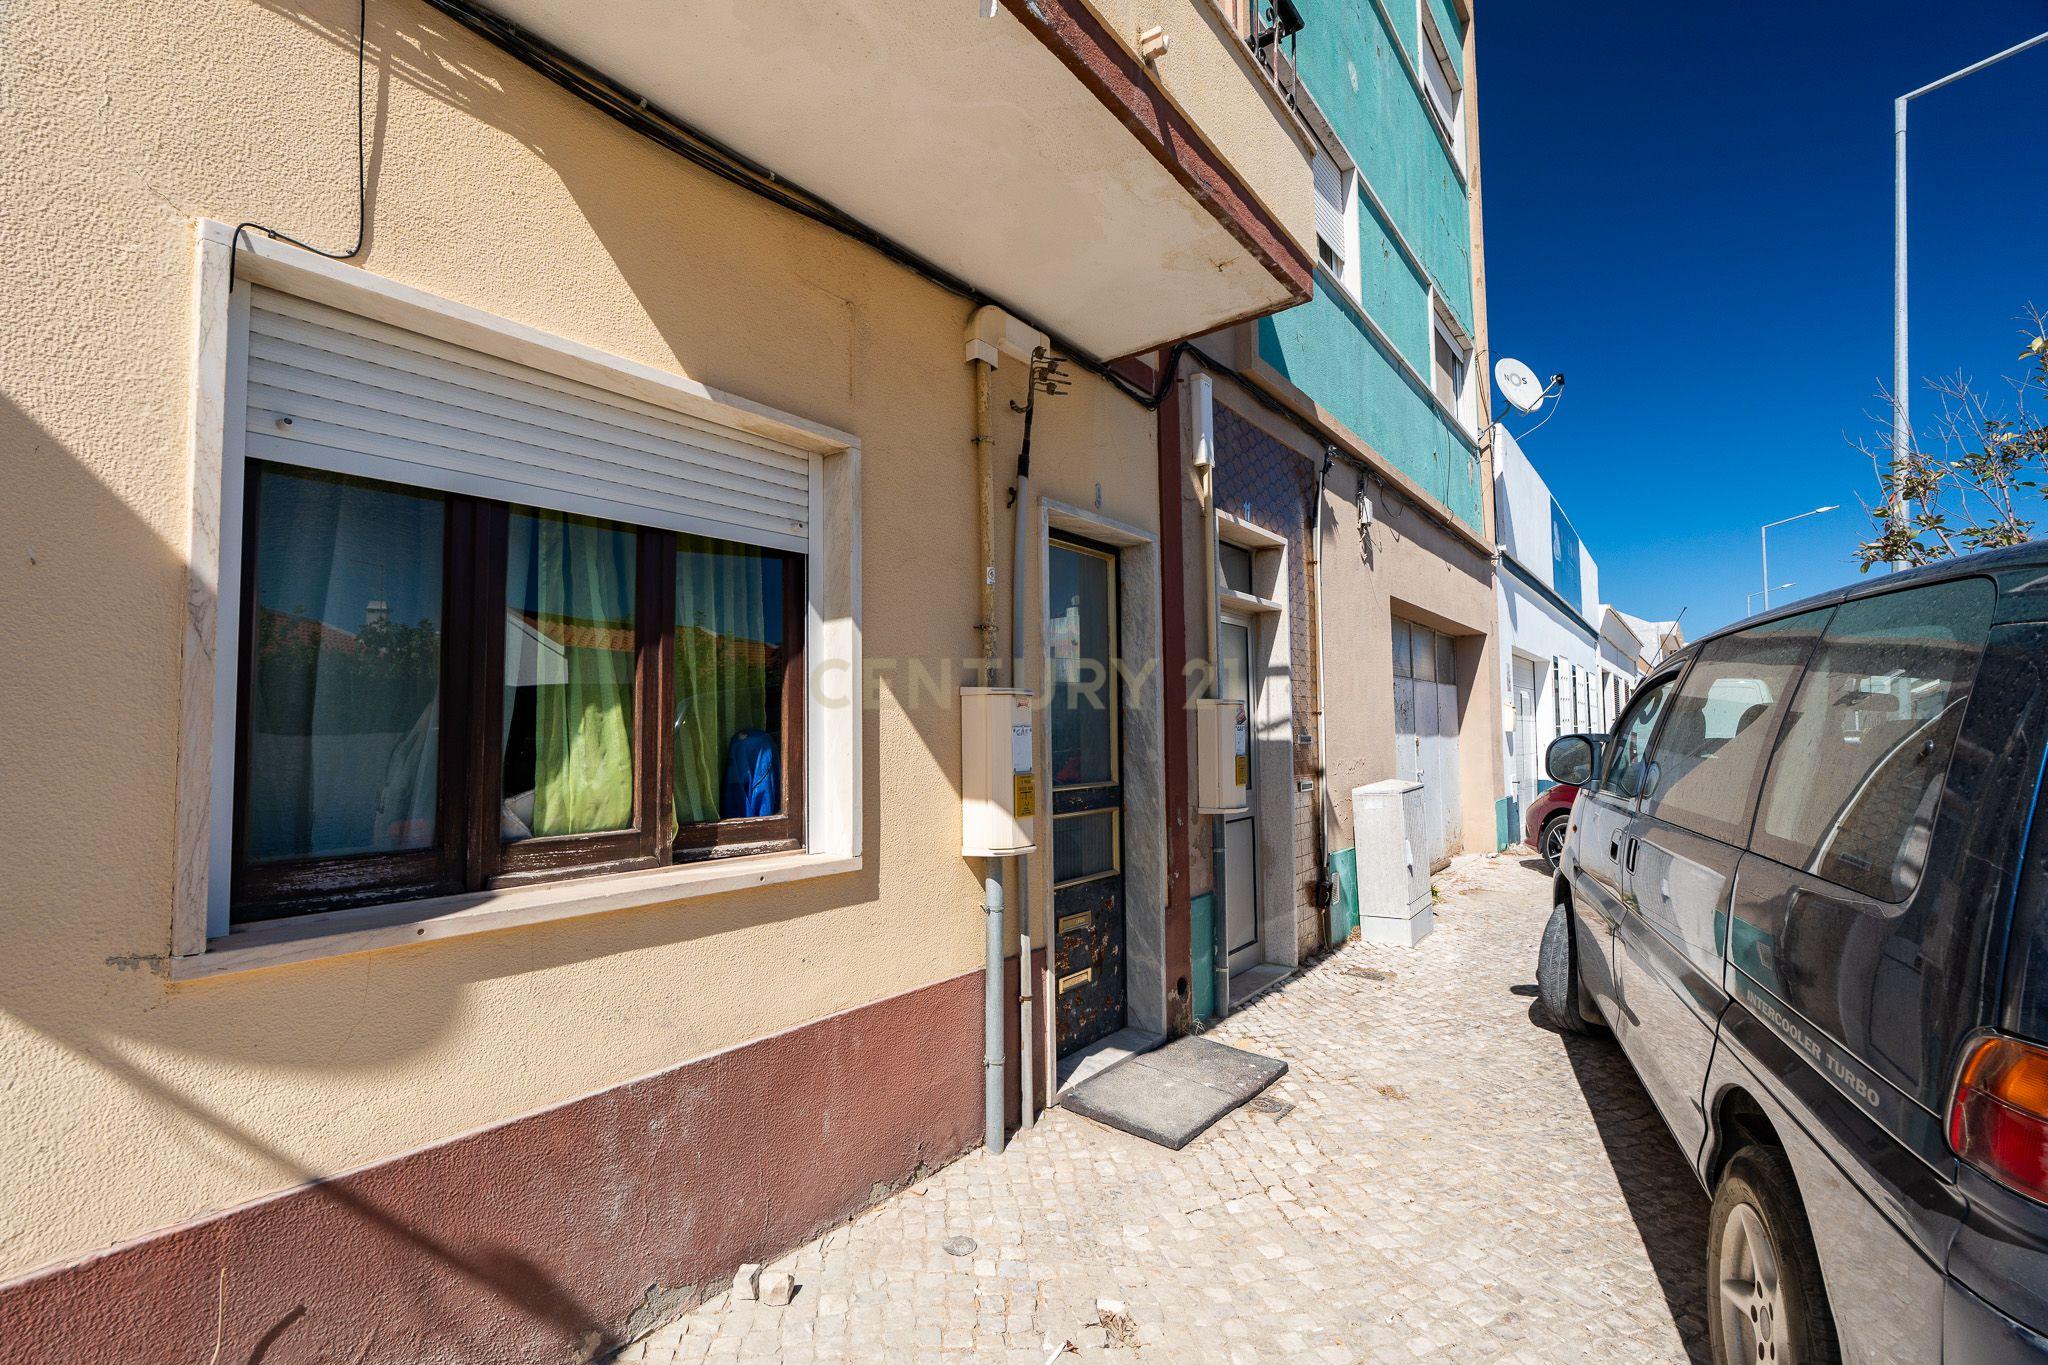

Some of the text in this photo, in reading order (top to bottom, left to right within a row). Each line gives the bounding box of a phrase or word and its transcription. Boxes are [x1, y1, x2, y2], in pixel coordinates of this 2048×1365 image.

[1504, 372, 1528, 387] NOS
[1746, 989, 1880, 1108] INTERCOOLER TURBO
